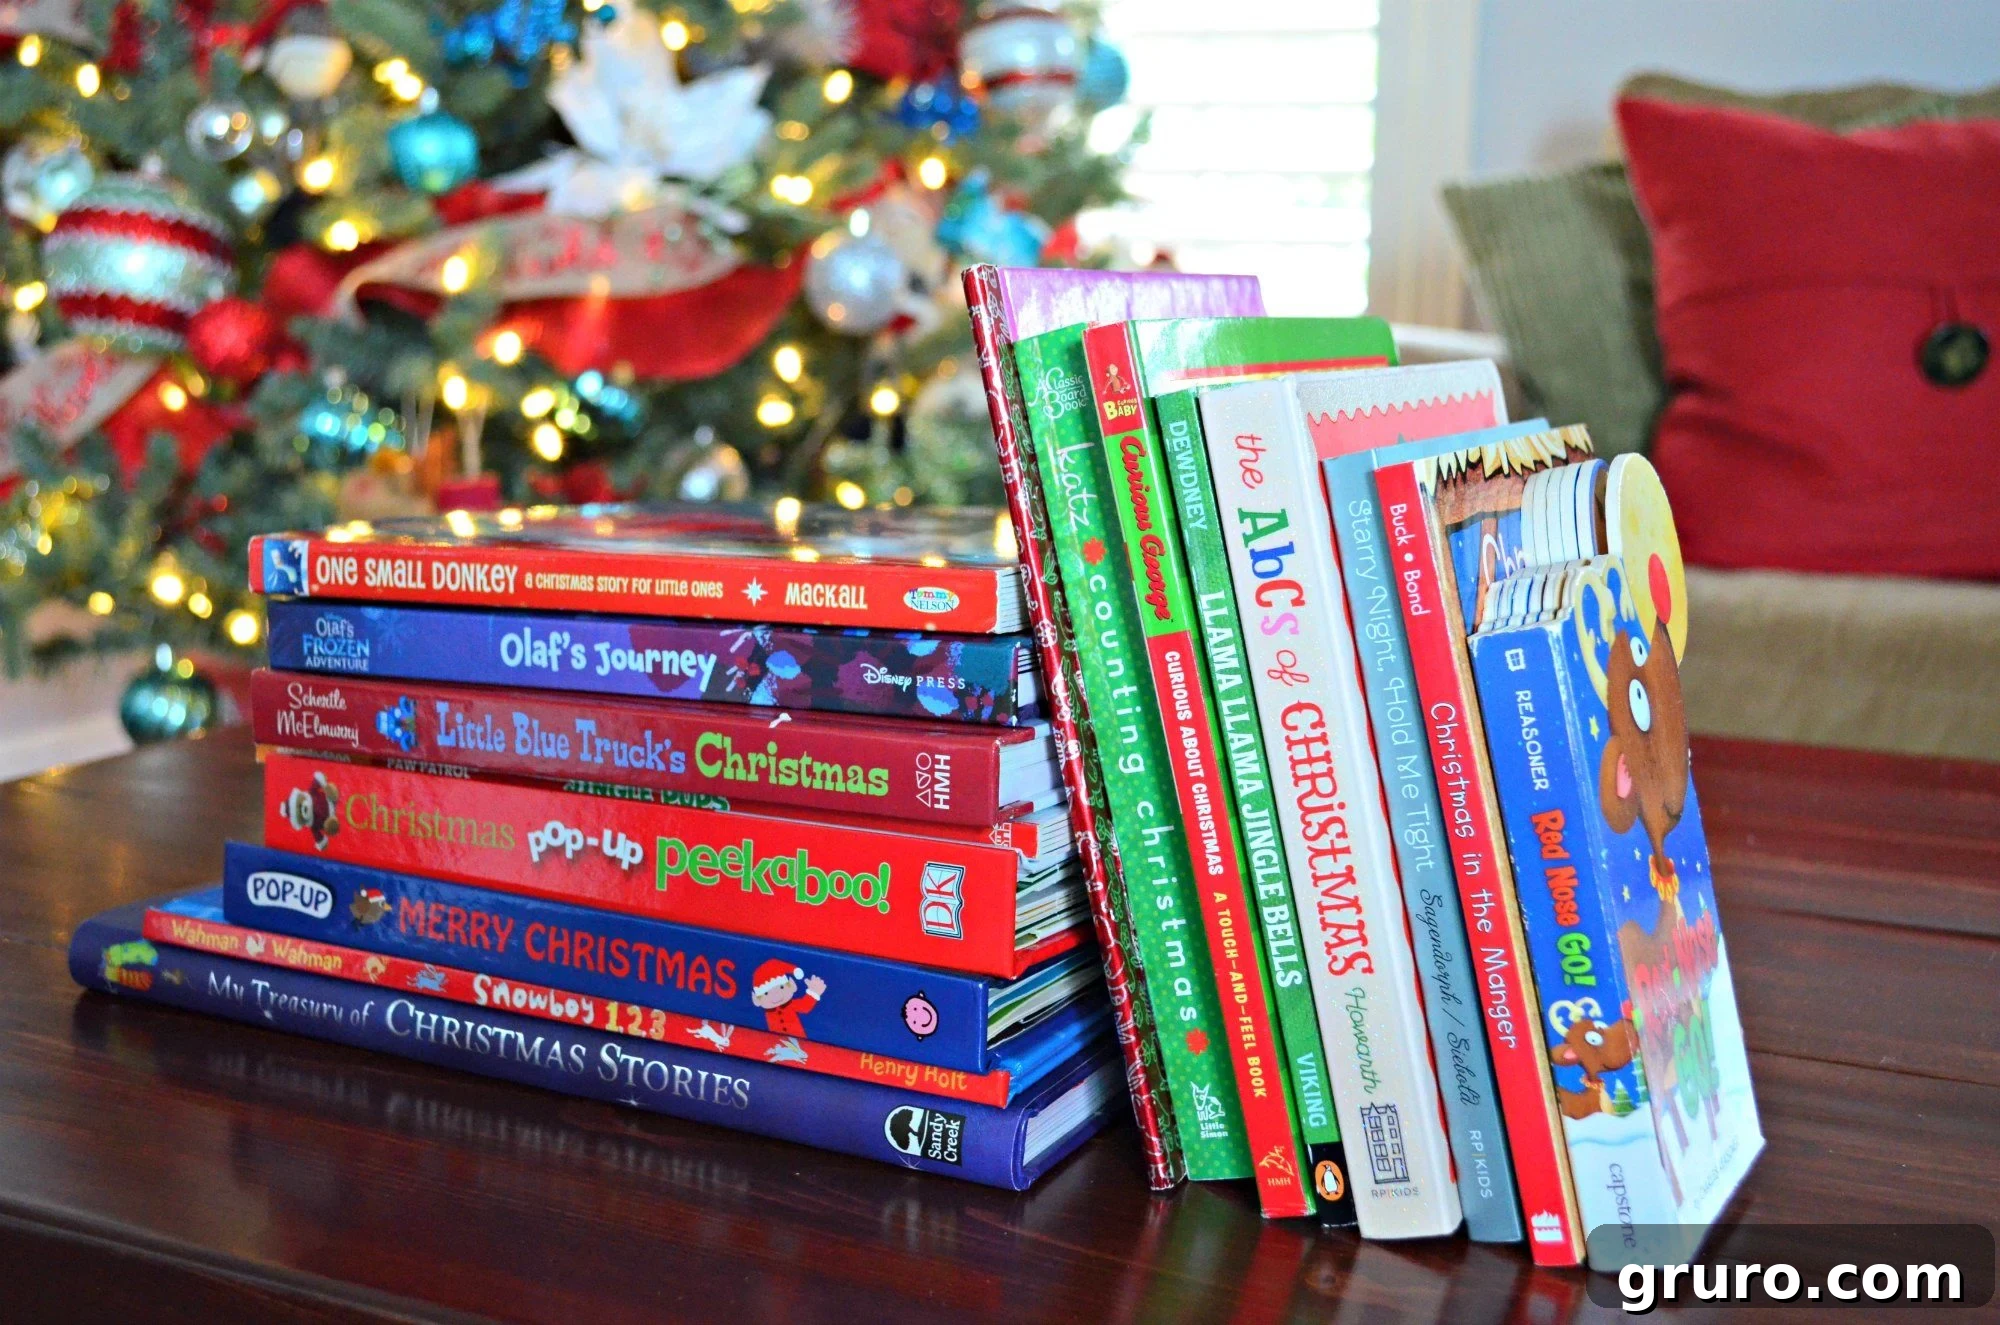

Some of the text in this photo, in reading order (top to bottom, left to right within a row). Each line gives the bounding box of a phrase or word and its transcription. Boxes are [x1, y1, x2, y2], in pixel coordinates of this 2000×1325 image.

[1046, 366, 1083, 391] Classic
[1103, 400, 1138, 420] BABY
[1169, 420, 1207, 530] DEWDNEY
[1120, 436, 1172, 621] Curious George
[1349, 499, 1378, 581] Starry
[1389, 503, 1416, 546] Buck
[1235, 434, 1266, 489] the
[1267, 650, 1309, 687] of
[1403, 569, 1431, 617] Bond
[909, 588, 956, 602] Tommy
[910, 600, 954, 612] NELSON
[303, 633, 370, 657] FROZEN
[305, 656, 369, 671] ADVENTURE
[501, 626, 717, 693] Olaf's Journey
[916, 675, 966, 690] PRESS
[1383, 677, 1414, 746] Hold
[436, 701, 889, 796] Little Blue Truck's Christmas
[1165, 651, 1224, 876] CURIOUS ABOUT CHRISTMAS
[1515, 690, 1549, 791] REASONER
[933, 753, 951, 810] HMH
[1089, 574, 1197, 1022] counting christmas
[1200, 590, 1302, 988] LLAMA LLAMA JINGLE BELLS
[1396, 755, 1422, 800] Me
[345, 794, 515, 851] Christmas
[656, 836, 891, 914] peekaboo!
[1404, 803, 1435, 872] Tight
[252, 876, 329, 913] POP-UP
[924, 866, 960, 932] DK
[1431, 702, 1516, 1050] Christmas in the Manger
[1530, 809, 1571, 860] Red
[1556, 932, 1597, 987] GO!
[171, 919, 240, 950] Wahman
[272, 939, 343, 970] Wahman
[399, 896, 738, 999] MERRY CHRISTMAS
[473, 973, 594, 1025] Snowboy
[1213, 892, 1228, 905] A
[1247, 1056, 1268, 1098] BOOK
[1416, 889, 1462, 1006] Sagendorph
[1446, 1032, 1480, 1106] Siebold
[207, 971, 751, 1110] My Treasury of CHRISTMAS STORIES
[859, 1052, 968, 1091] Henry Holt
[1296, 1052, 1328, 1128] VIKING
[927, 1112, 946, 1160] Sandy
[943, 1119, 962, 1163] Creek
[1200, 1121, 1225, 1131] Little
[1200, 1130, 1229, 1139] Simon
[1267, 1177, 1291, 1187] HMH
[1607, 1163, 1637, 1248] capstone
